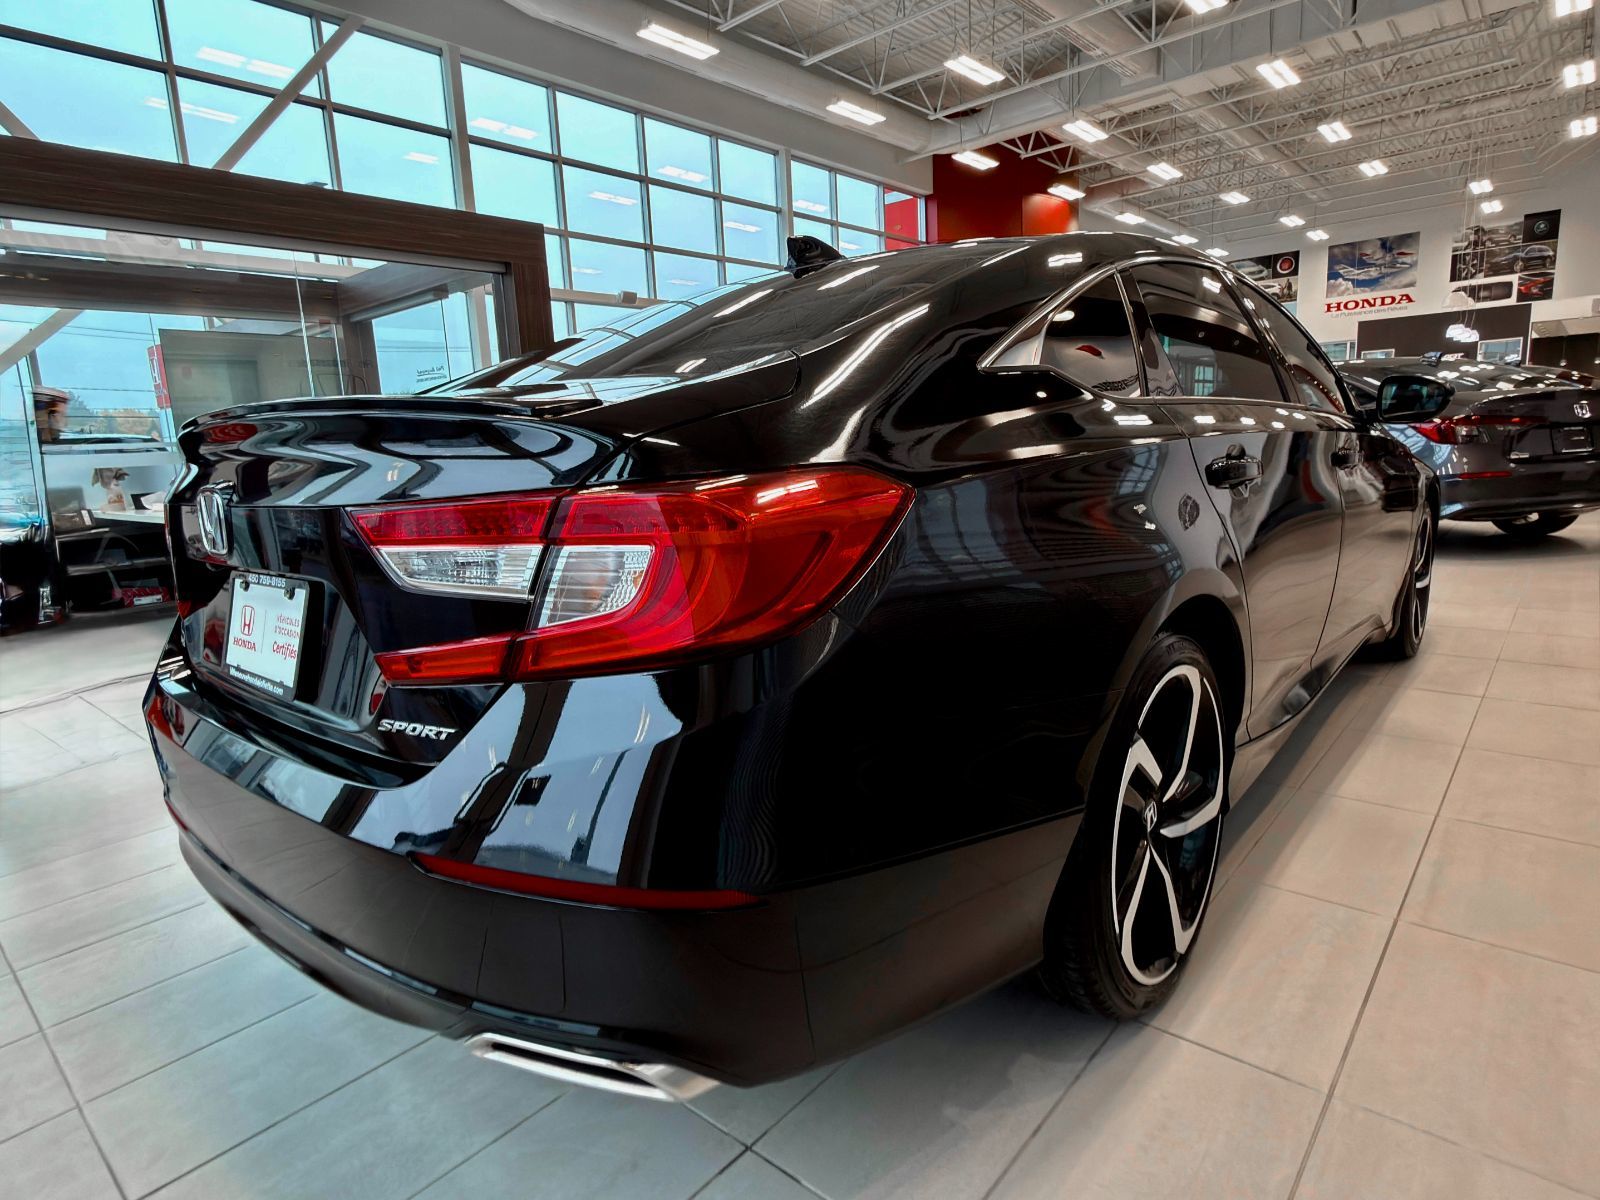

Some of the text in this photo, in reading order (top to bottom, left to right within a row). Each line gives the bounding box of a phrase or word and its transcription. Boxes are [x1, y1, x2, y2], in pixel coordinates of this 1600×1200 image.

[1325, 294, 1415, 313] HONDA
[233, 637, 256, 652] HONDA
[272, 641, 297, 660] Certifiés
[378, 719, 457, 740] SPORT
